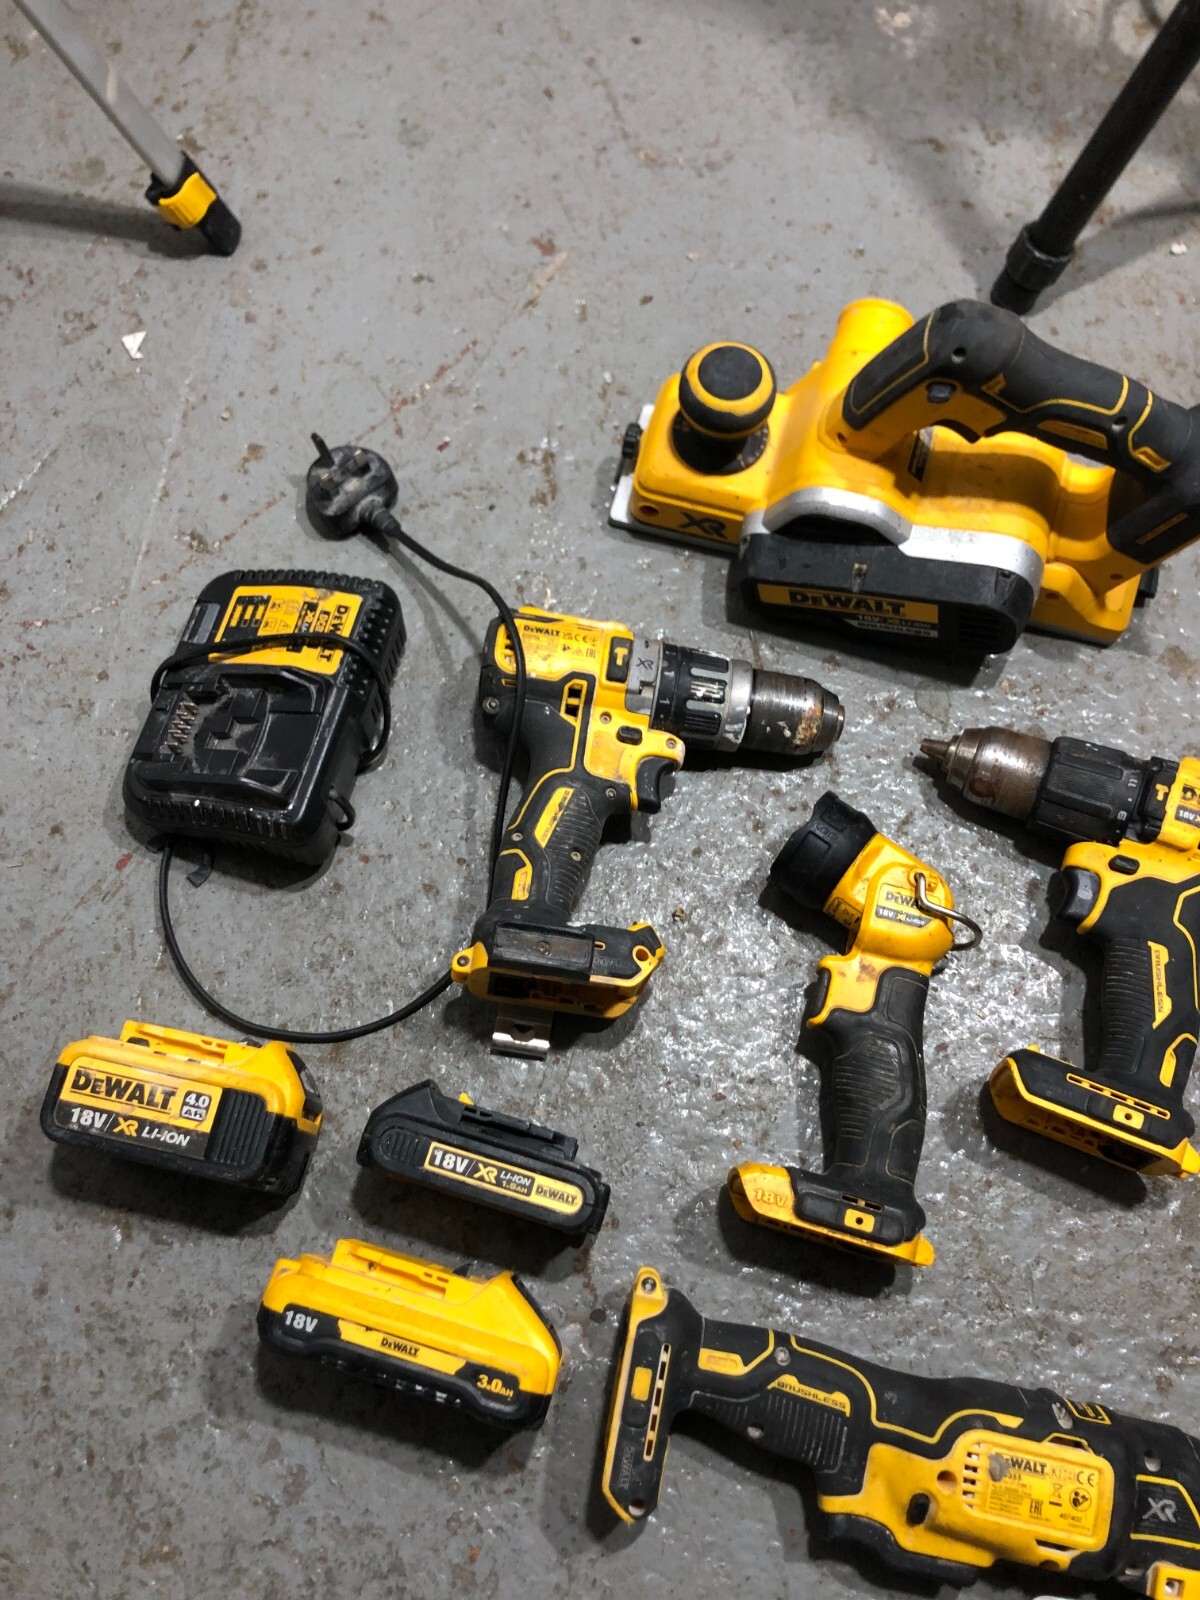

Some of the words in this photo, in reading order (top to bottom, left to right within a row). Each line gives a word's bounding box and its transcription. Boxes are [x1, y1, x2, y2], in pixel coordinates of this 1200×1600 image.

[680, 511, 727, 540] XR
[320, 606, 349, 662] DeWLT
[185, 1092, 210, 1109] 4.0
[70, 1107, 109, 1129] 18V
[113, 1117, 138, 1137] XR
[433, 1148, 469, 1173] 18V
[473, 1162, 497, 1184] XR
[285, 1310, 318, 1333] 18V
[776, 1381, 846, 1410] BRUSHLESS
[1142, 1497, 1177, 1523] XR
